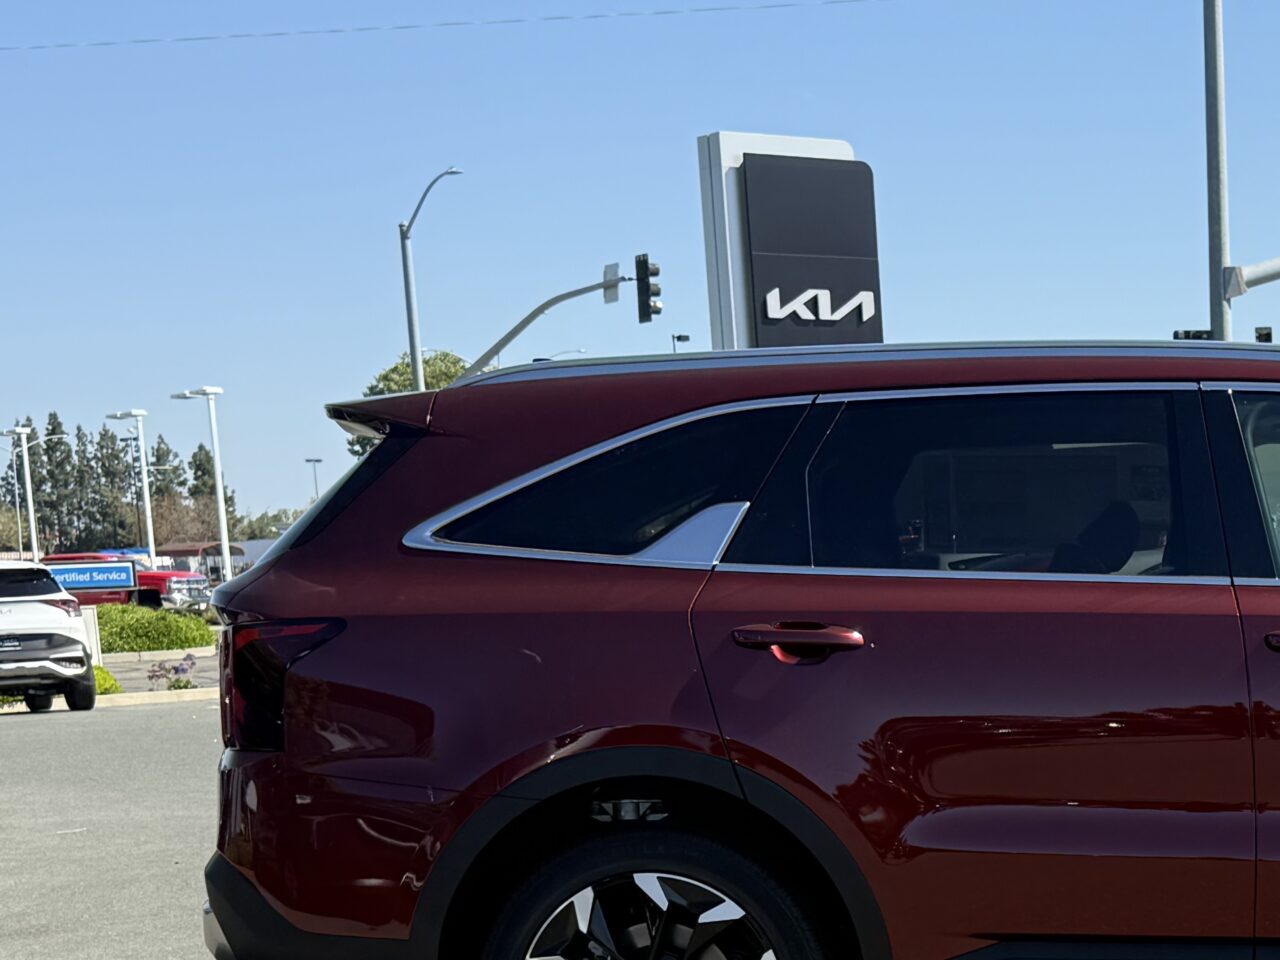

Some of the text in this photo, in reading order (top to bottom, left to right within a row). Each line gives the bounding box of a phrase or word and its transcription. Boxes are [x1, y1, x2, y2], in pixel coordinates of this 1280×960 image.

[765, 287, 876, 322] KIA
[53, 569, 127, 583] ertified Service
